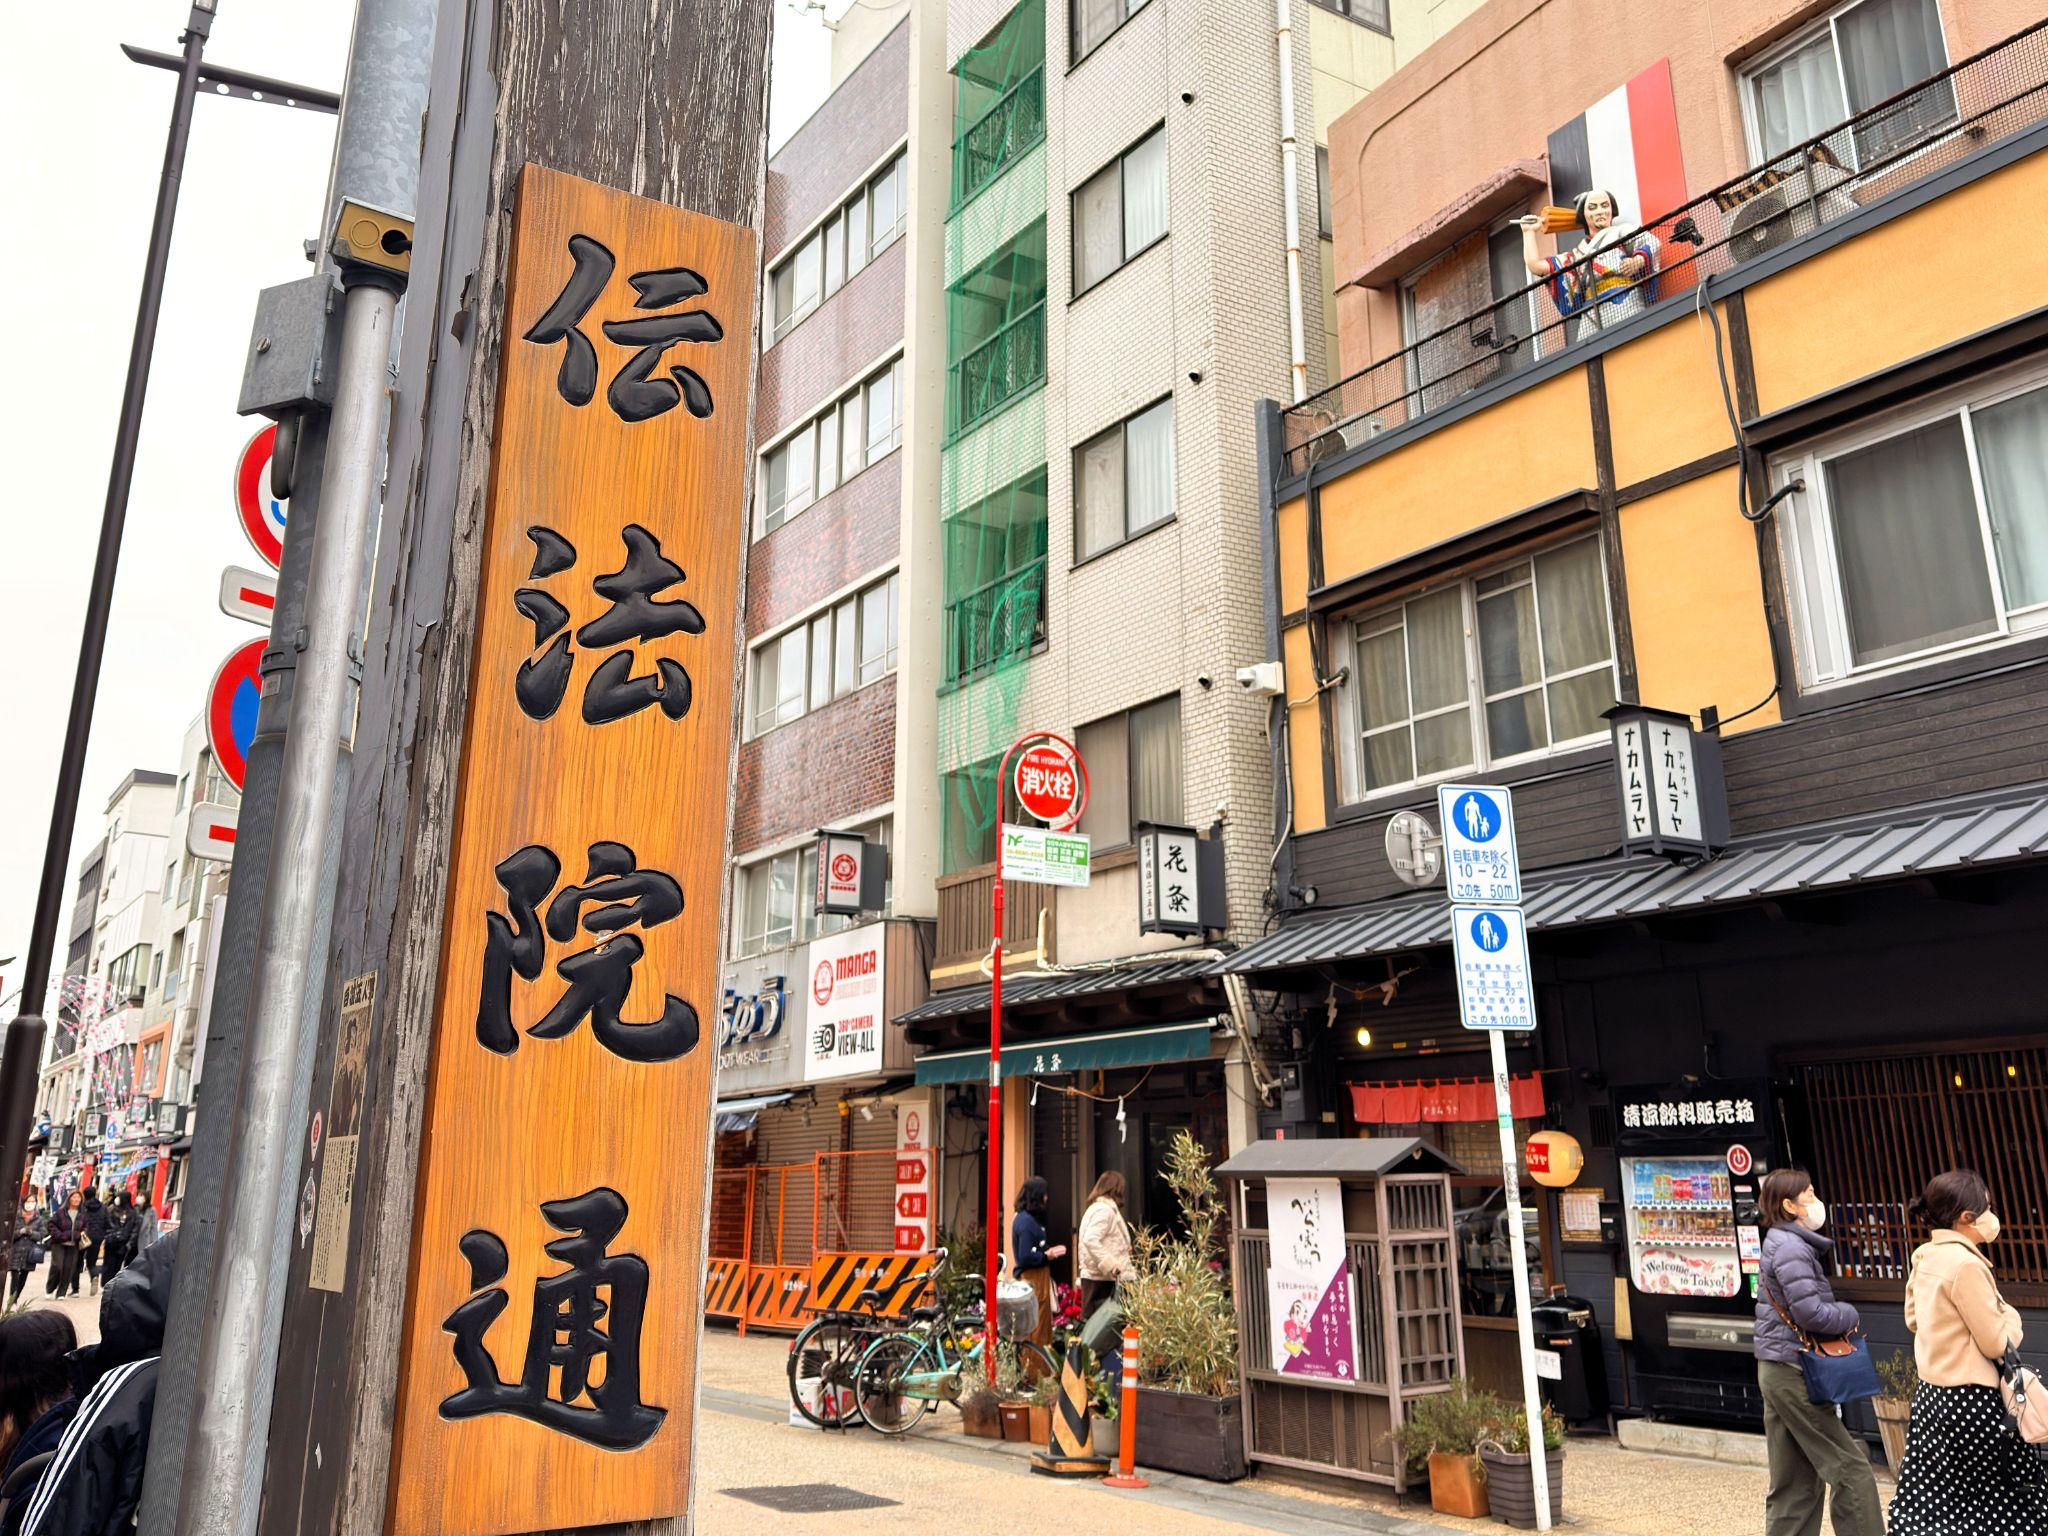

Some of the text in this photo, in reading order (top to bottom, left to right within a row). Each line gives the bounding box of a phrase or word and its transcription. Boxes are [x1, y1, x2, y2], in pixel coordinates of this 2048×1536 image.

[1027, 755, 1067, 767] FIRE HYDRANT
[1022, 766, 1072, 799] 消火栓
[1625, 728, 1645, 833] ナカムラヤ
[1662, 728, 1681, 832] ナカムラヤ
[438, 233, 724, 1452] 伝法院通
[1454, 849, 1509, 864] 自転車を除く
[1459, 864, 1473, 878] 10
[1492, 864, 1507, 879] 22
[1457, 884, 1514, 898] この先 50m
[836, 950, 876, 981] MANGA
[838, 1030, 875, 1057] VIEW-ALL
[1623, 1098, 1755, 1128] 清涼飲料販売箱
[1646, 1261, 1690, 1276] Welcome
[1680, 1274, 1725, 1288] to Tokyo!
